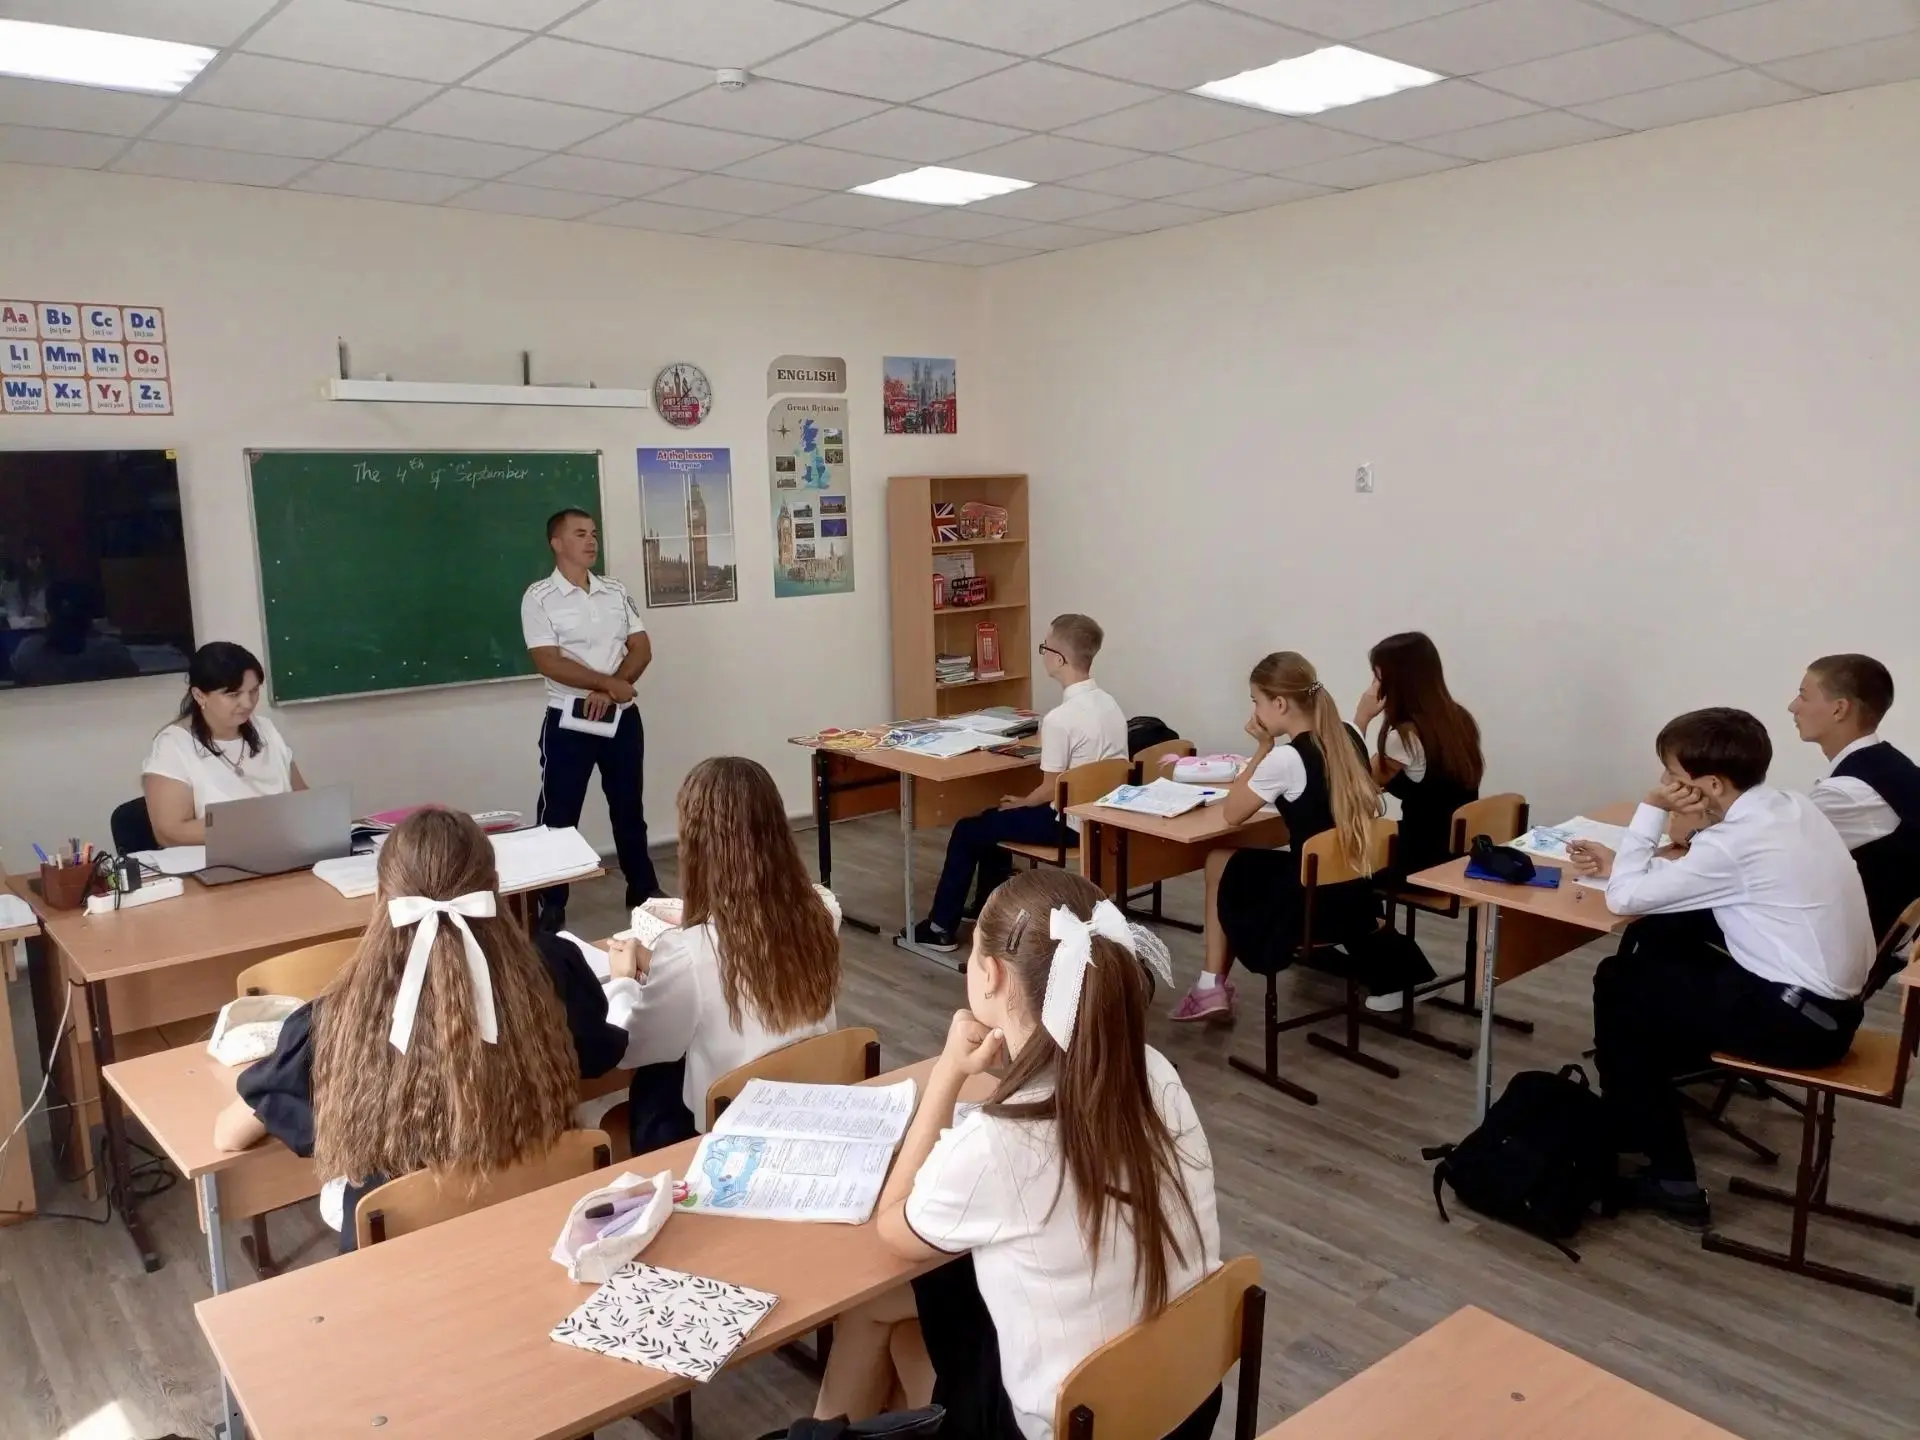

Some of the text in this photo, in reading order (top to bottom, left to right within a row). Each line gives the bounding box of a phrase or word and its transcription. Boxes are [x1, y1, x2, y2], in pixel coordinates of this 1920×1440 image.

[2, 307, 29, 324] Aa
[46, 308, 72, 326] Bb
[90, 311, 113, 328] Cc
[130, 312, 156, 329] Dd
[46, 346, 82, 363] Mm
[91, 347, 120, 364] Nn
[134, 349, 160, 365] Oo
[776, 368, 837, 382] ENGLISH
[5, 381, 42, 398] Ww
[53, 382, 82, 399] Xx
[96, 383, 122, 402] Yy
[139, 384, 162, 401] Zz
[787, 403, 839, 413] Great Britain
[657, 448, 714, 461] At the lesson
[353, 461, 381, 484] The
[429, 468, 446, 489] of
[454, 464, 529, 488] September
